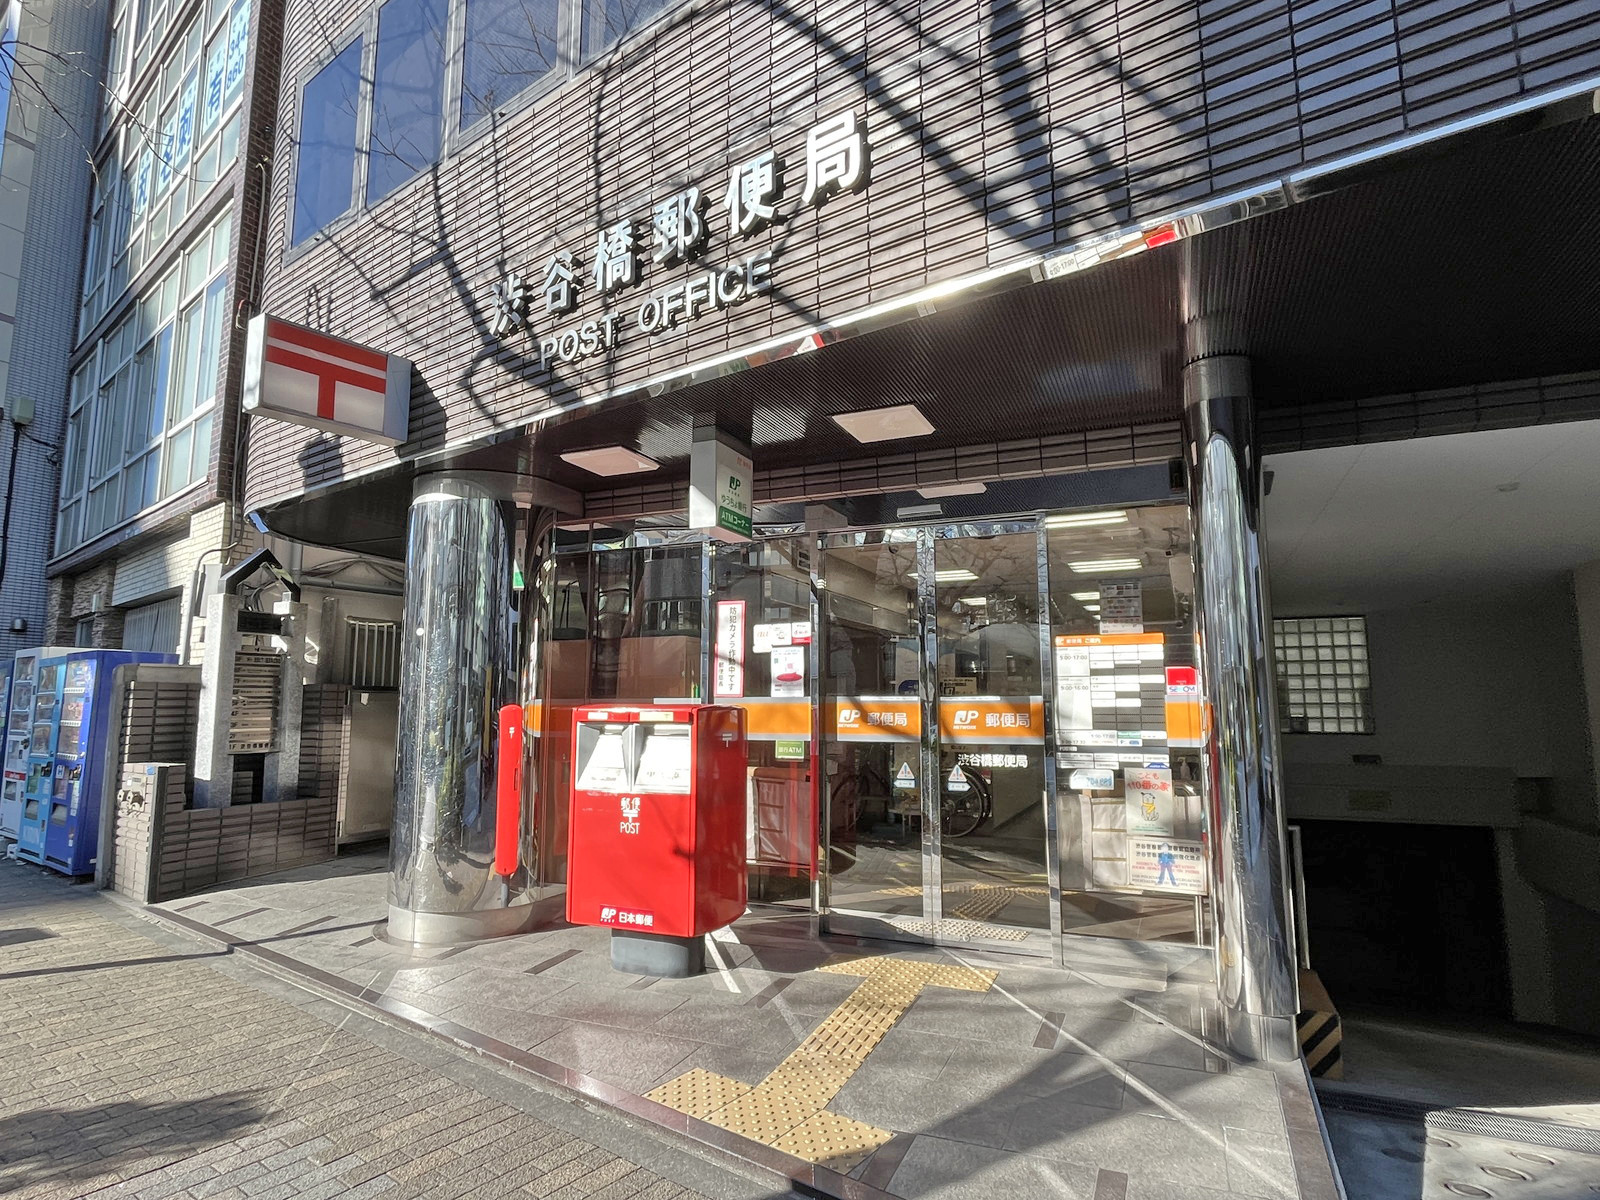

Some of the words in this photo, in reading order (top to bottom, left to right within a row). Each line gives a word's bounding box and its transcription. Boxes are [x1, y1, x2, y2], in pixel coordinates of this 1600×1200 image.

[489, 110, 865, 337] 渋谷橋郵便局
[539, 311, 621, 371] POST
[638, 250, 774, 333] OFFICE
[721, 494, 747, 513] ゆうちょ銀行
[721, 511, 750, 527] ATMコーナー
[728, 606, 737, 691] 防犯カメラ作動中です
[867, 712, 908, 727] 郵便局
[985, 712, 1031, 728] 郵便局
[958, 754, 1028, 768] 渋谷橋郵便局
[1137, 772, 1159, 780] こども
[1127, 780, 1171, 792] 110番の家
[620, 797, 641, 811] 郵便
[620, 821, 640, 834] POST
[618, 911, 654, 927] 日本郵便
